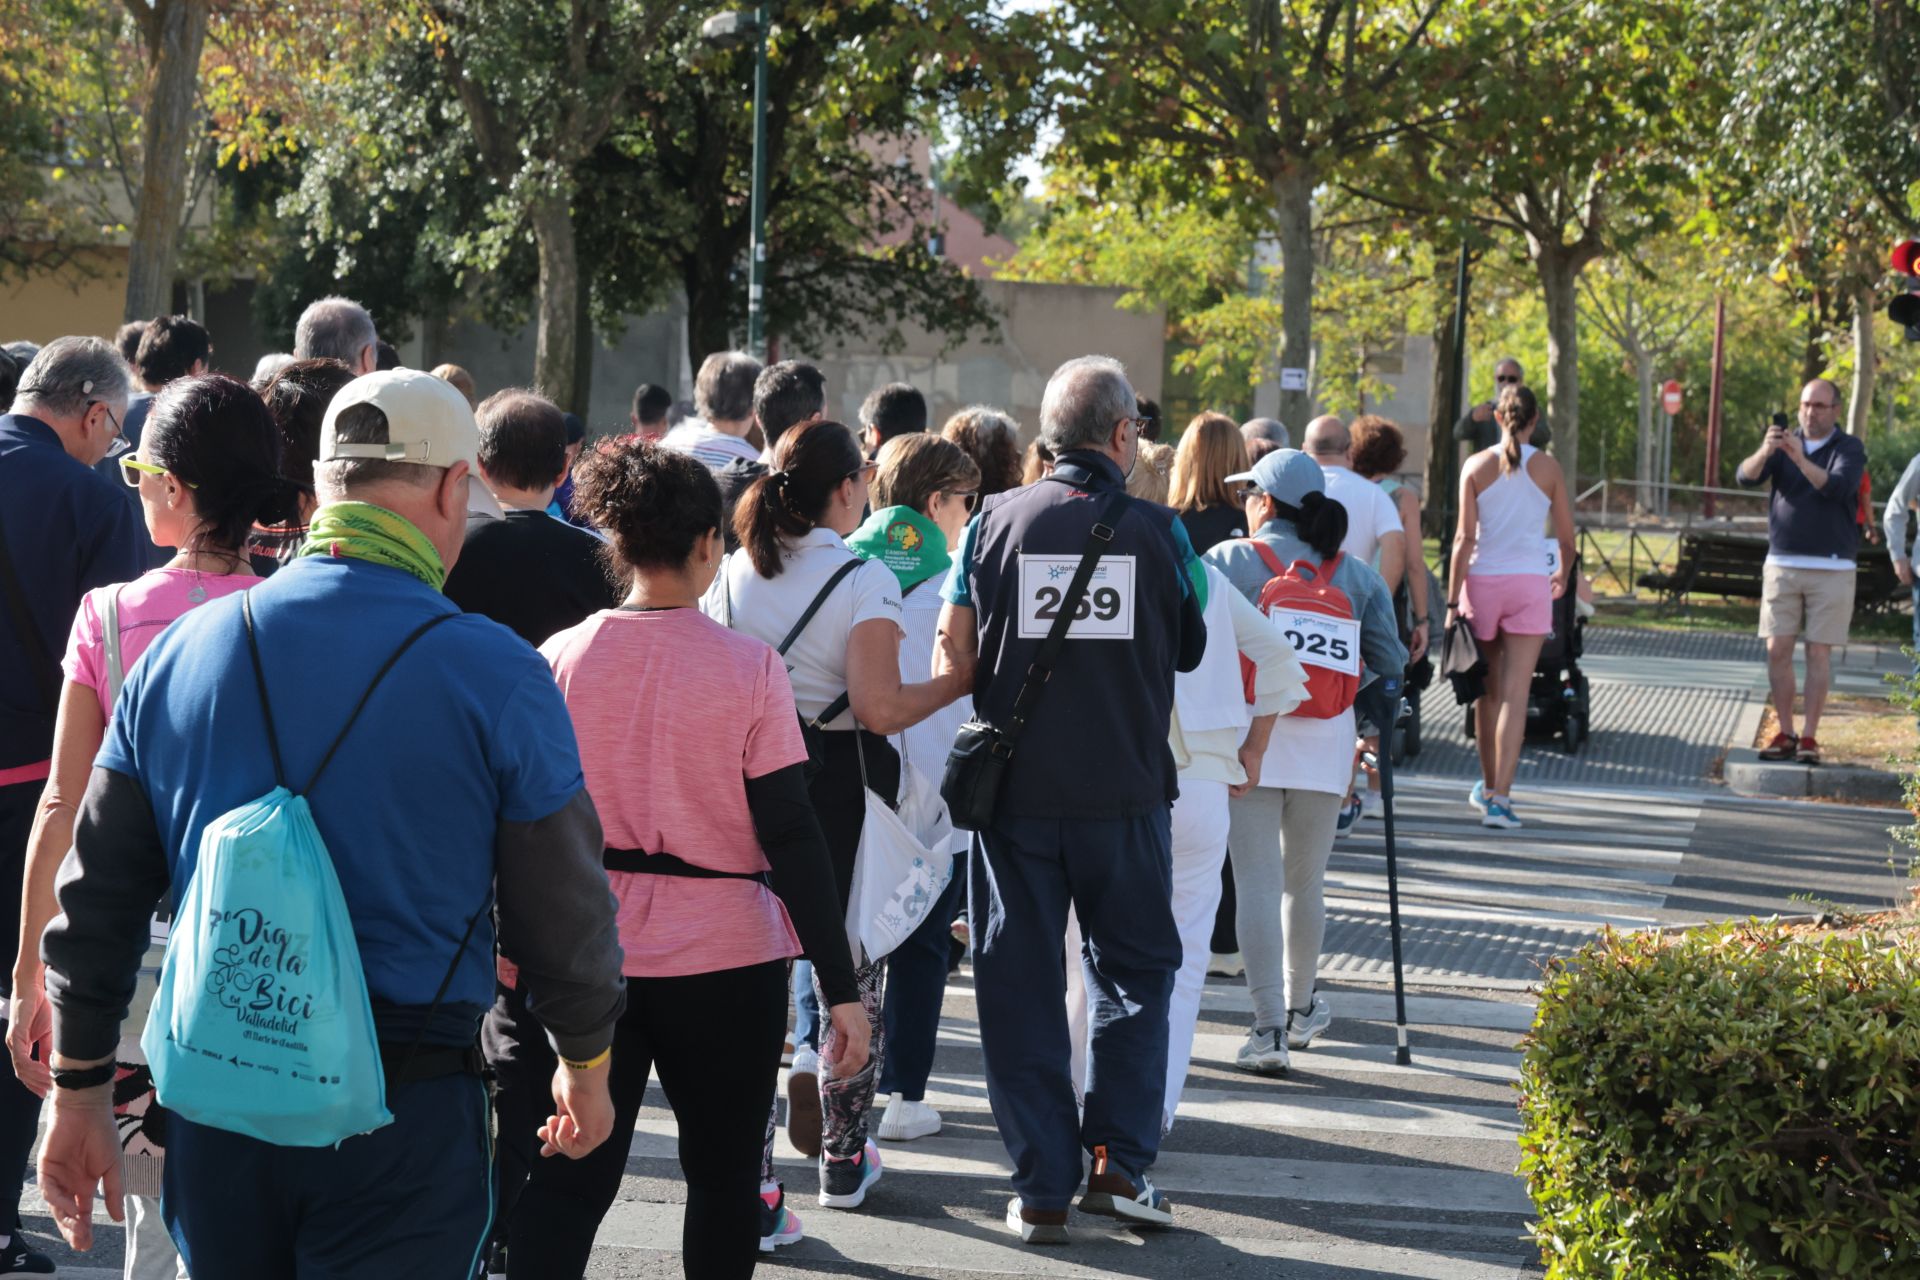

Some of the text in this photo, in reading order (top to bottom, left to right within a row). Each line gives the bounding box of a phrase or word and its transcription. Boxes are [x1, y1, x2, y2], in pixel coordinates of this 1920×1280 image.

[232, 908, 292, 945] Día
[249, 945, 271, 968] de
[277, 938, 307, 976] la
[249, 973, 316, 1019] Bici
[237, 1006, 298, 1036] Valladolid
